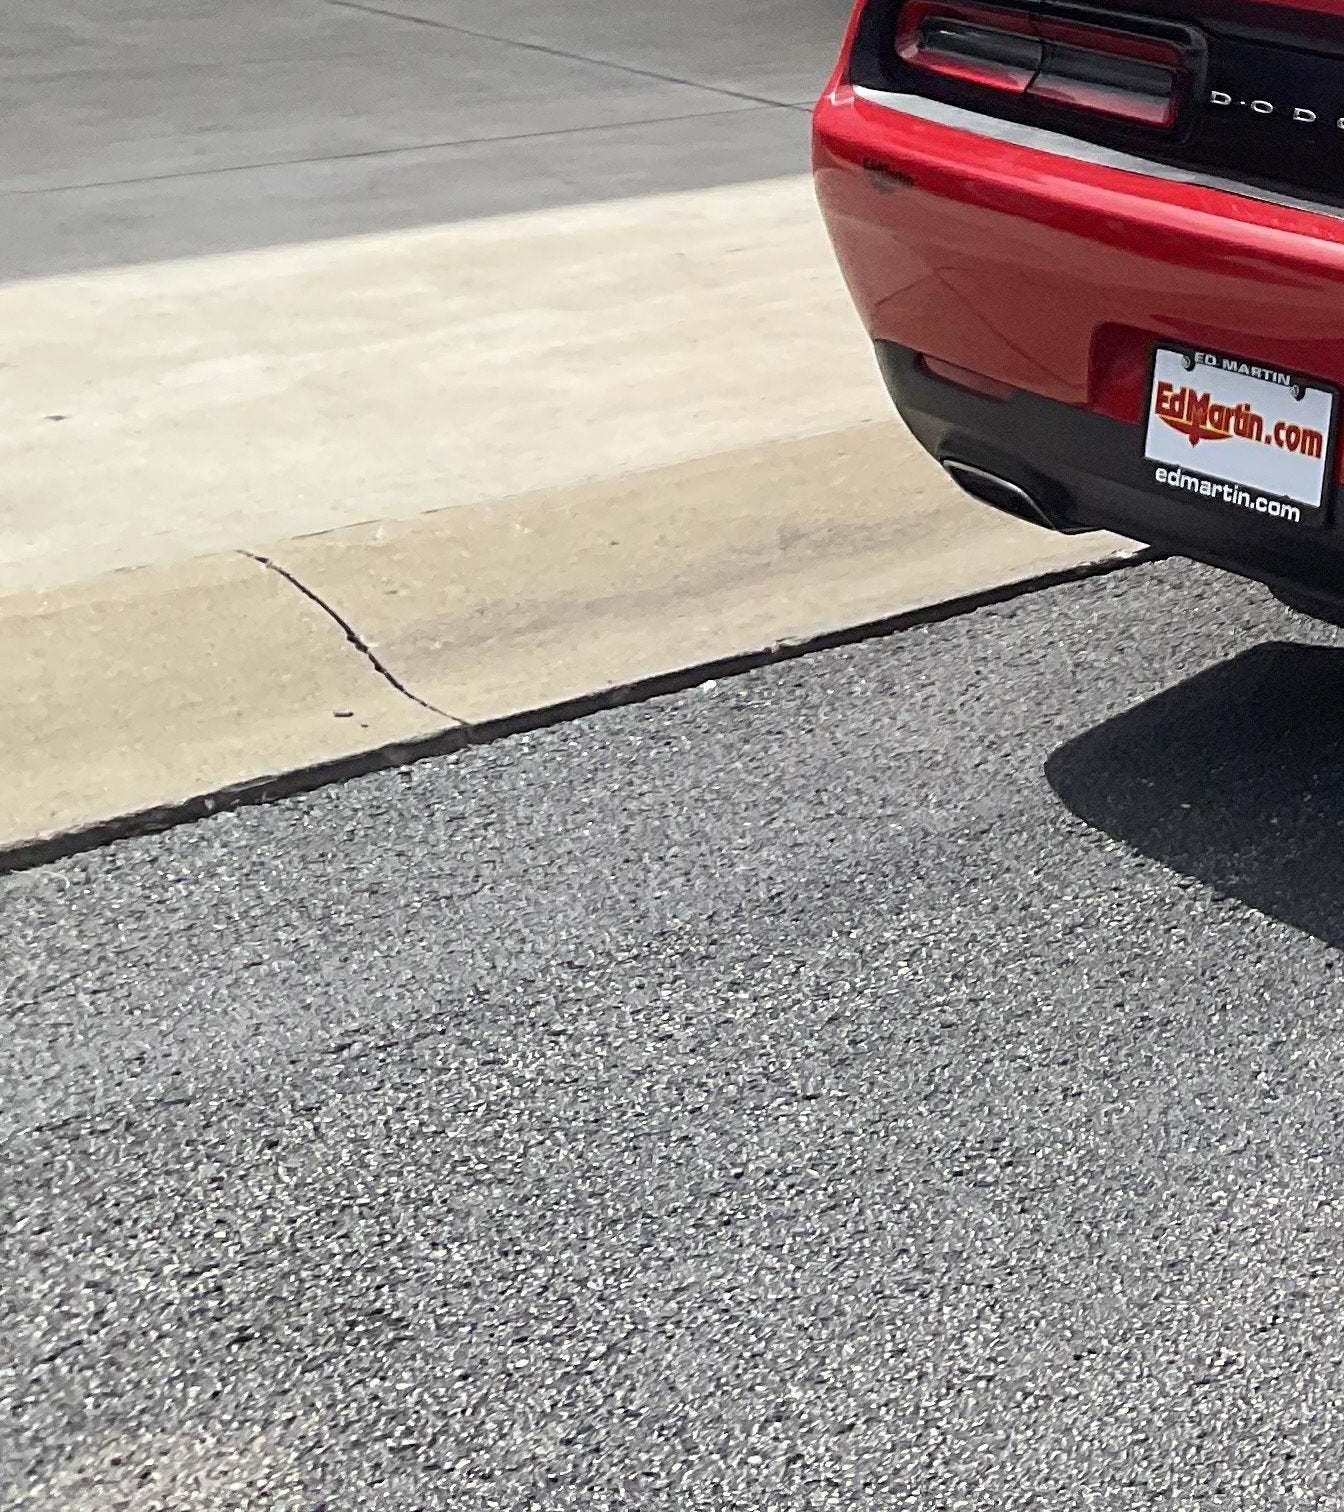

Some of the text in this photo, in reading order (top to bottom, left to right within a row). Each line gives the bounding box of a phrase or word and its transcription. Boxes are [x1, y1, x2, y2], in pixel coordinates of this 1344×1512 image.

[1194, 352, 1291, 386] ED MARTIN
[1155, 381, 1323, 459] EdMartin.com
[1155, 466, 1301, 523] edmartin.com
